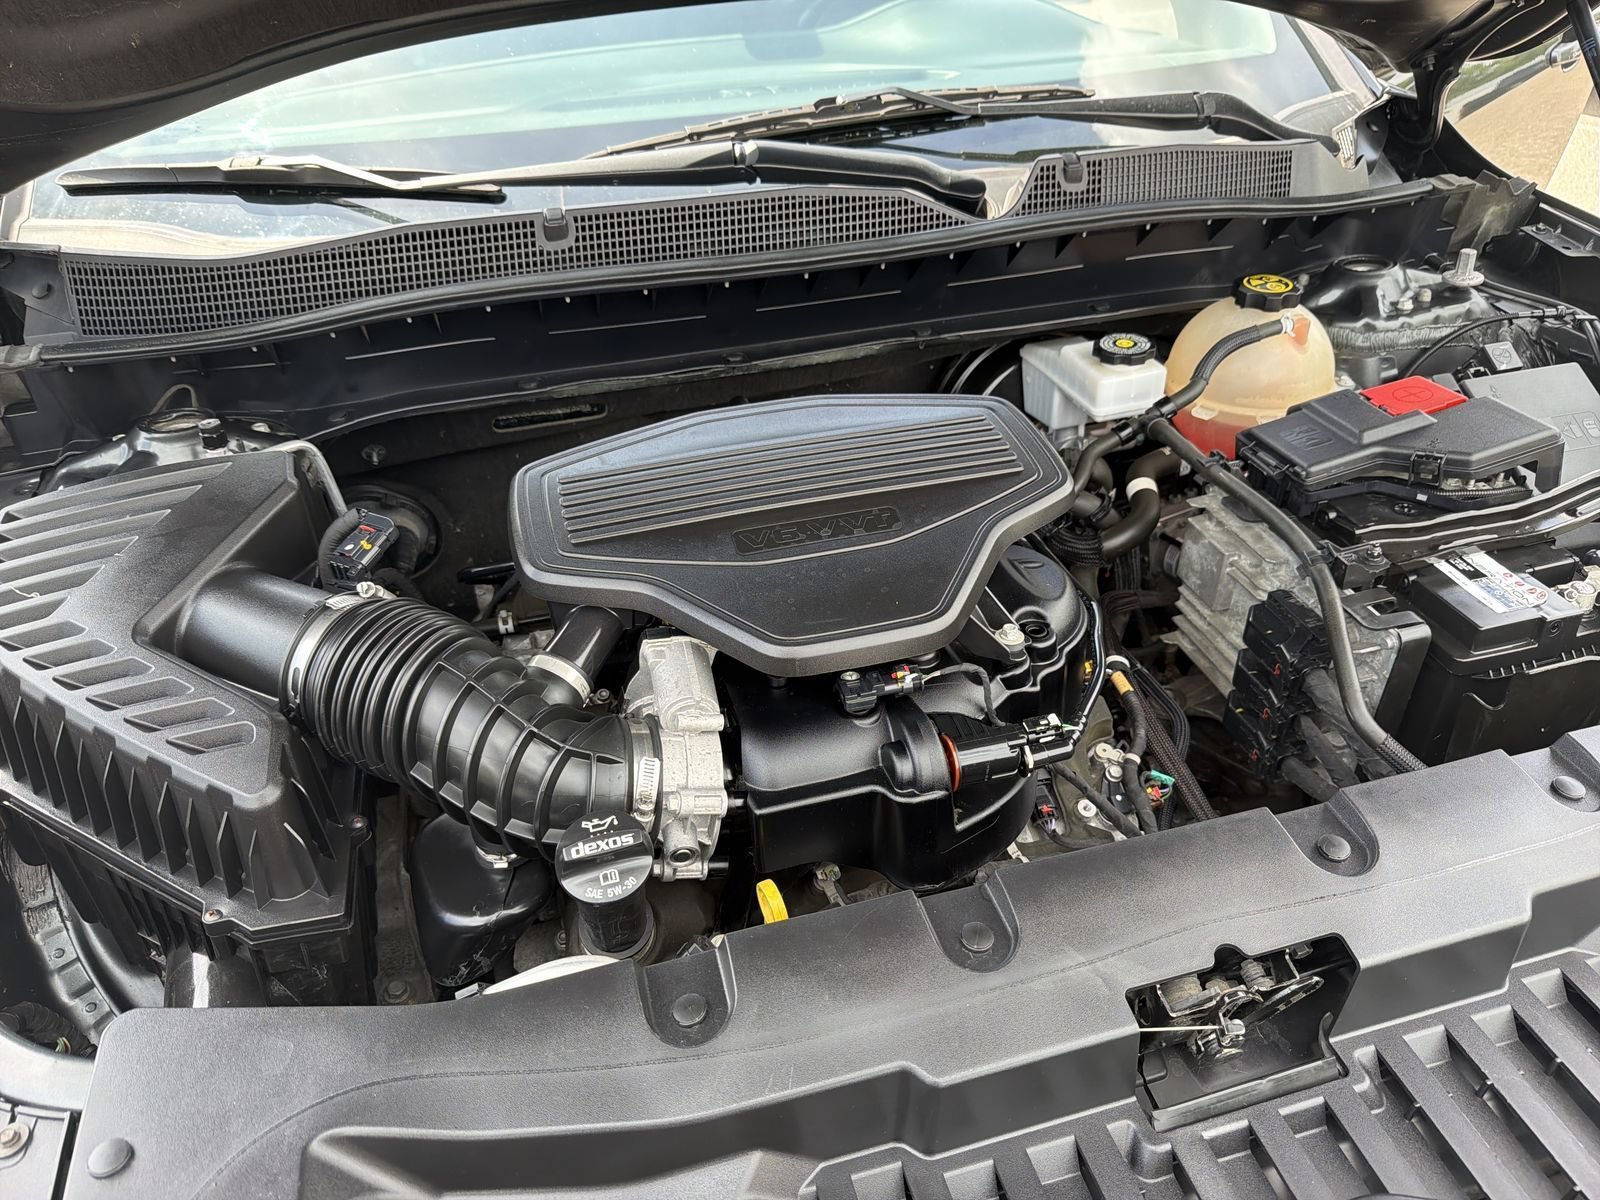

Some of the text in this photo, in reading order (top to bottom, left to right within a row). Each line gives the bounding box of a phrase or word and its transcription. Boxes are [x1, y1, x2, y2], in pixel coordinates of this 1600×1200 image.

[738, 526, 802, 548] V6
[570, 833, 635, 859] dexos
[585, 876, 637, 899] SAE 5W-30
